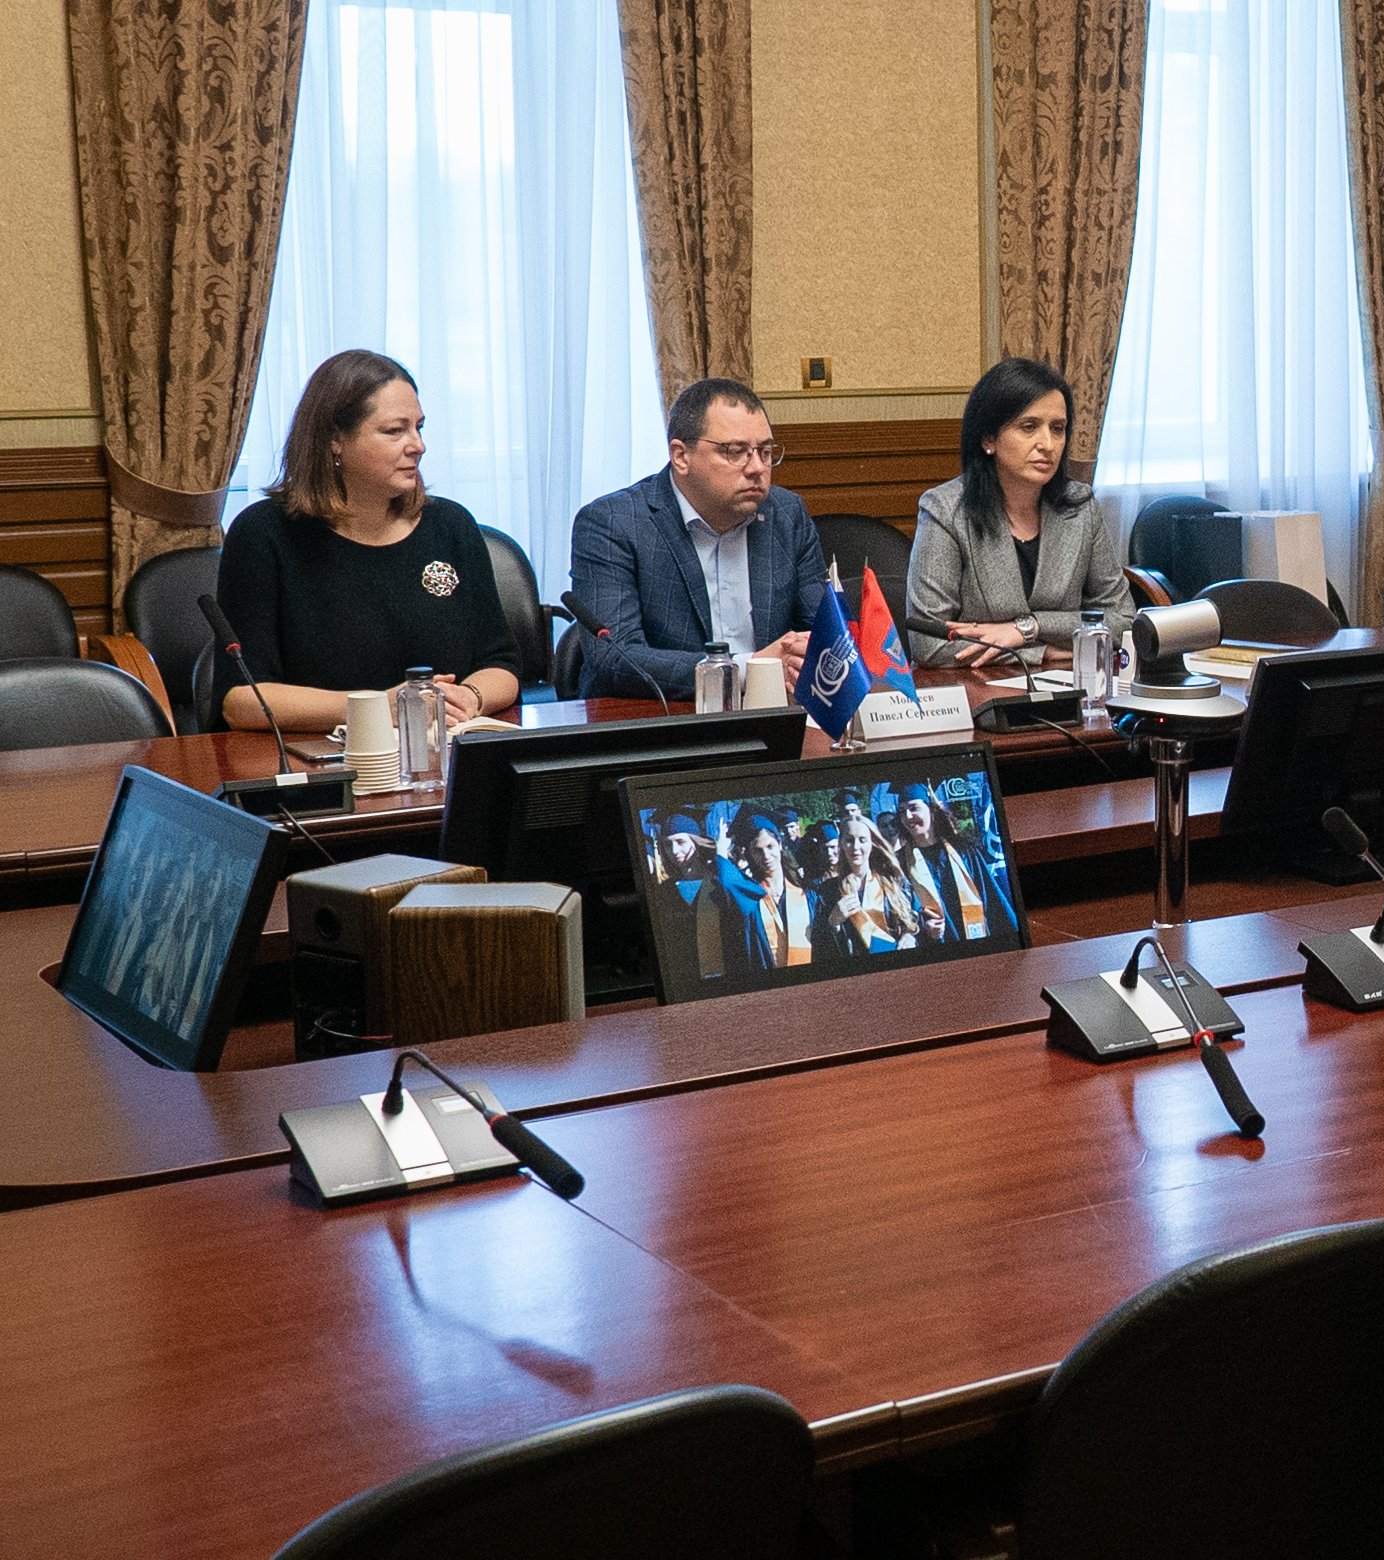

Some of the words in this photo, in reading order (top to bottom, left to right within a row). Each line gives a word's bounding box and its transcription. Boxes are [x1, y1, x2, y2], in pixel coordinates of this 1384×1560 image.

[889, 694, 935, 706] Моиеев
[870, 711, 903, 723] Павел
[906, 706, 960, 721] Сергеевич
